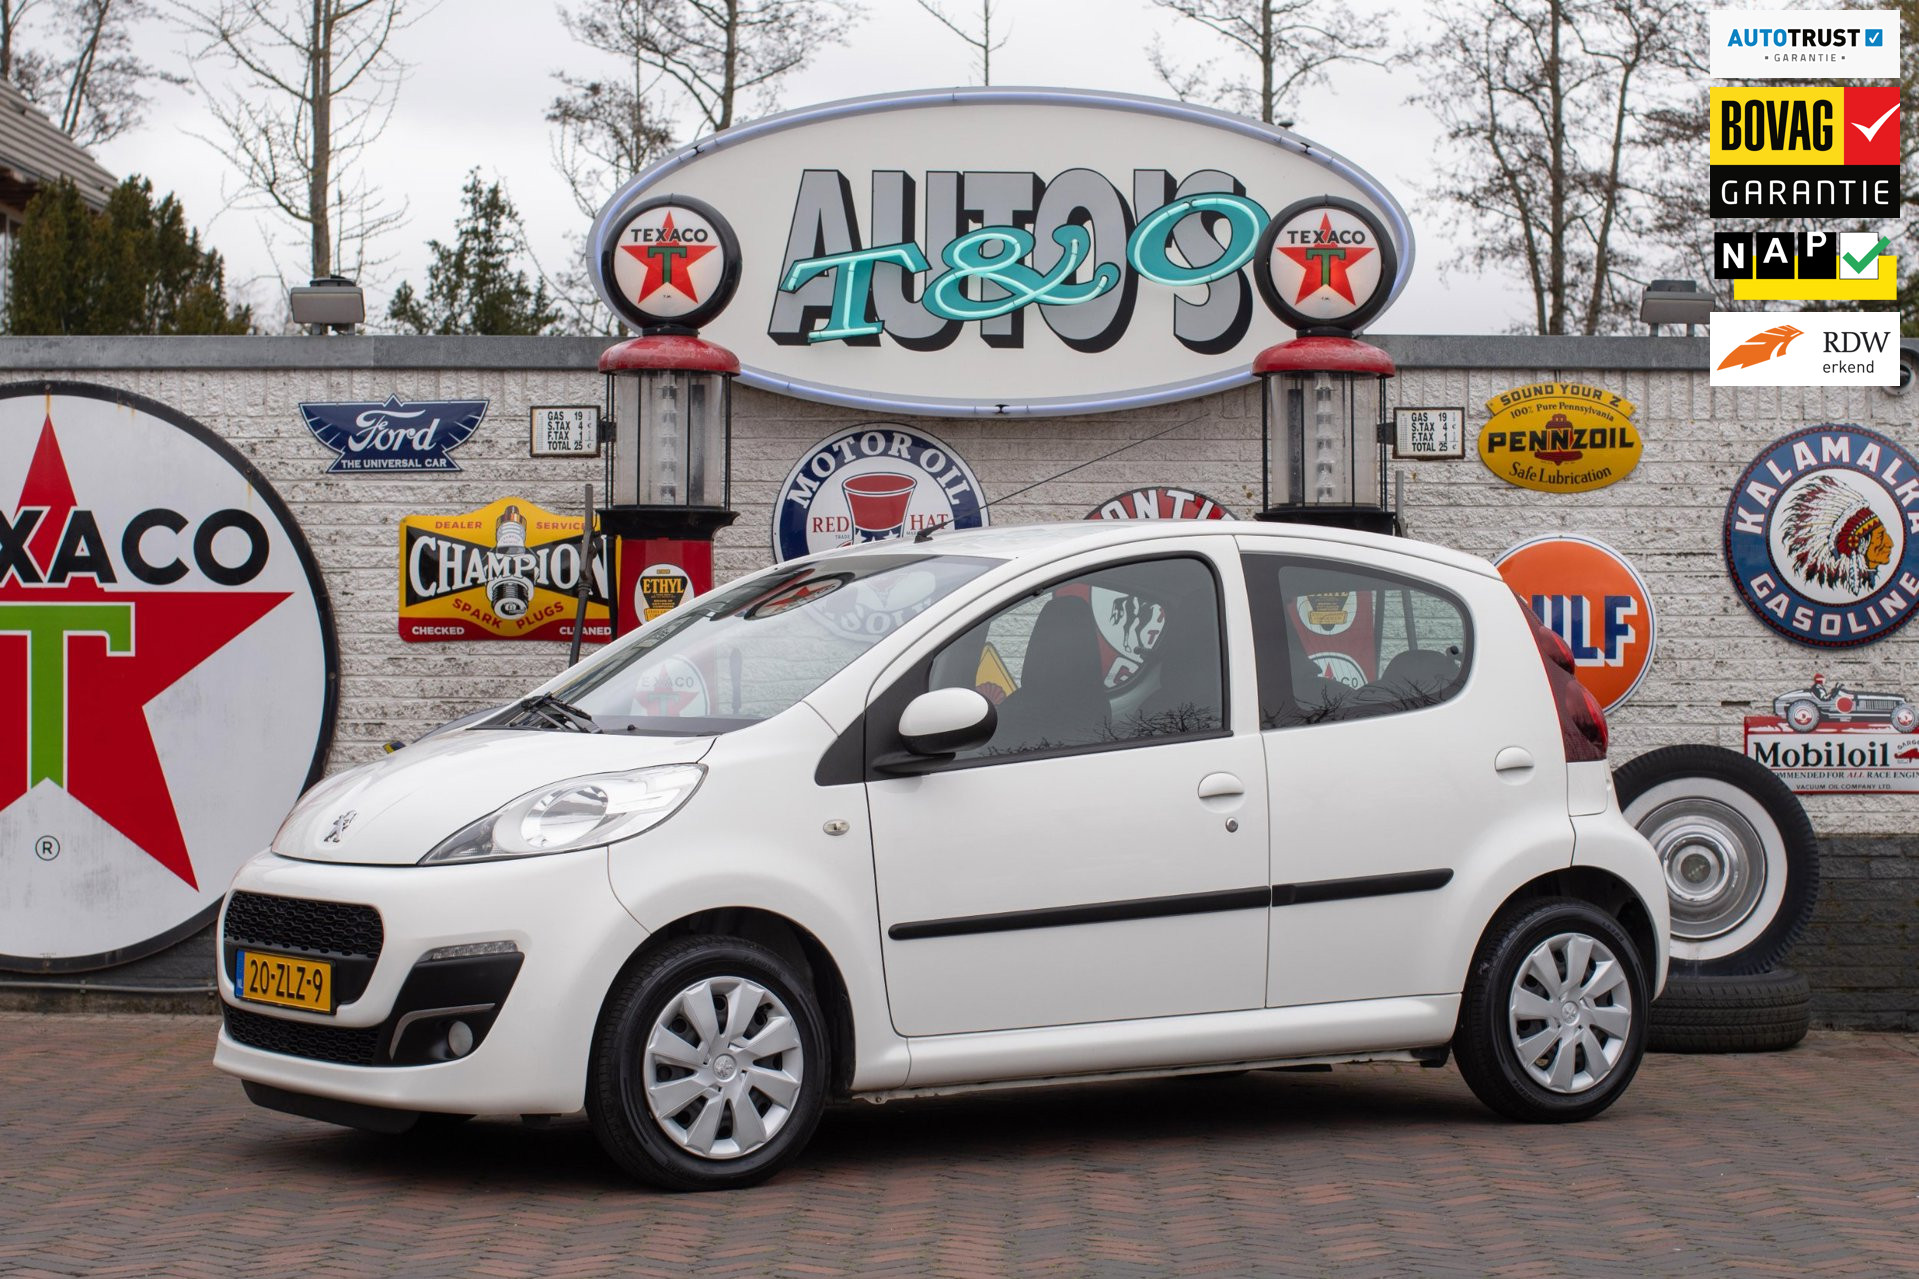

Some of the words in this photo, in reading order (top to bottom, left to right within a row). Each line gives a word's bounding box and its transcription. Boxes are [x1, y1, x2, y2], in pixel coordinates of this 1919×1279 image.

[631, 228, 709, 243] TEXACO
[1287, 230, 1366, 245] TEXACO
[1500, 384, 1554, 406] SOUND
[1560, 384, 1603, 401] YOUR
[1609, 395, 1622, 408] Z
[547, 411, 564, 421] GAS
[574, 411, 583, 421] 19
[1411, 412, 1429, 422] GAS
[1438, 412, 1447, 422] 19
[1536, 403, 1557, 412] Pure
[1559, 402, 1614, 422] Pennsylvania
[348, 409, 440, 452] Ford
[547, 421, 570, 431] S.TAX
[578, 422, 583, 431] 4
[1411, 422, 1435, 432] S.TAX
[1442, 422, 1448, 432] 4
[547, 431, 569, 440] F.TAX
[579, 431, 583, 440] 1
[1411, 432, 1434, 441] F.TAX
[1443, 432, 1448, 442] 1
[1488, 427, 1635, 453] PENNZOIL
[547, 441, 571, 450] TOTAL
[574, 441, 583, 450] 25
[1411, 442, 1436, 452] TOTAL
[1438, 442, 1448, 452] 25
[341, 459, 362, 469] THE
[363, 459, 422, 468] UNIVERSAL
[424, 458, 447, 467] CAR
[786, 431, 913, 509] MOTOR
[919, 448, 971, 505] OIL
[1509, 461, 1537, 481] Safe
[1539, 467, 1612, 485] Lubrication
[1735, 436, 1919, 534] KALAMALKA
[435, 521, 483, 529] DEALER
[536, 521, 585, 530] SERVIC
[812, 516, 850, 533] RED
[910, 513, 949, 531] HAT
[642, 578, 685, 594] ETHYL
[1750, 572, 1919, 636] GASOLINE
[452, 598, 503, 629] SPARK
[516, 601, 565, 629] PLUGS
[411, 626, 465, 635] CHECKED
[559, 626, 612, 635] CLANED
[1753, 741, 1890, 767] Mobiloil
[1827, 771, 1845, 779] FOR
[1867, 771, 1892, 779] RACE
[249, 958, 323, 1003] 20-ZLZ-9
